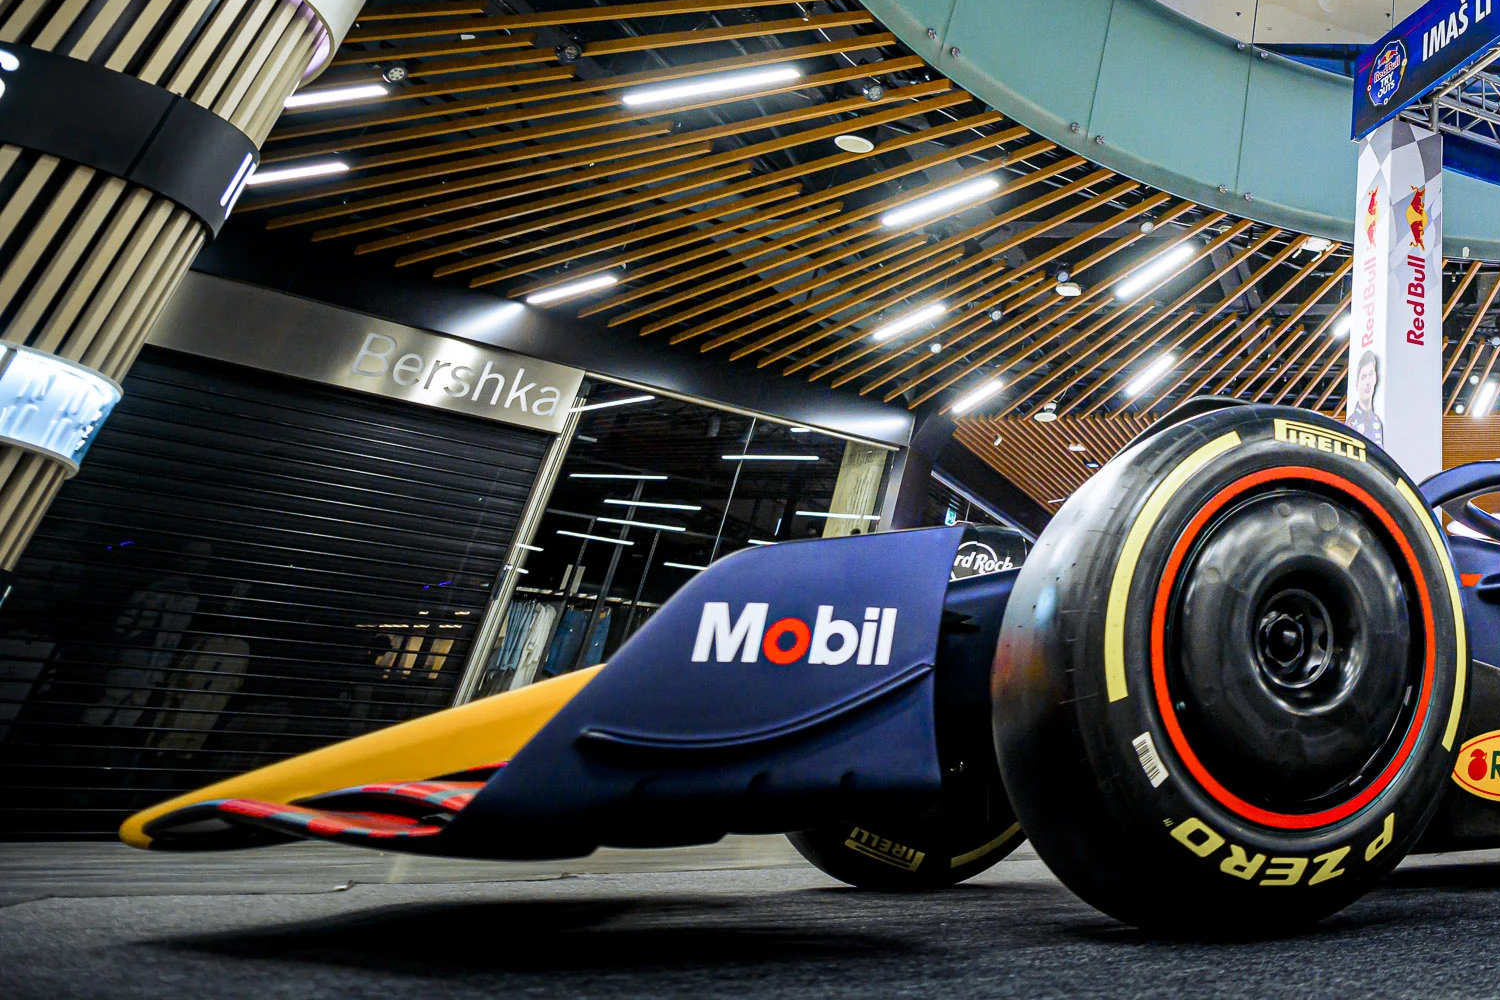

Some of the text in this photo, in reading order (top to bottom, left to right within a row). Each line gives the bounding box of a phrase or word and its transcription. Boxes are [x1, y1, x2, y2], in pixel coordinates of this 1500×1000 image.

[1378, 79, 1396, 98] OUTS
[1381, 71, 1394, 88] TRY
[351, 332, 561, 417] Bershka
[1273, 417, 1367, 463] PIRELLI
[954, 551, 977, 568] rd
[691, 601, 898, 666] Mobil
[844, 826, 925, 872] PIRELLI
[1170, 812, 1395, 886] P ZERO
